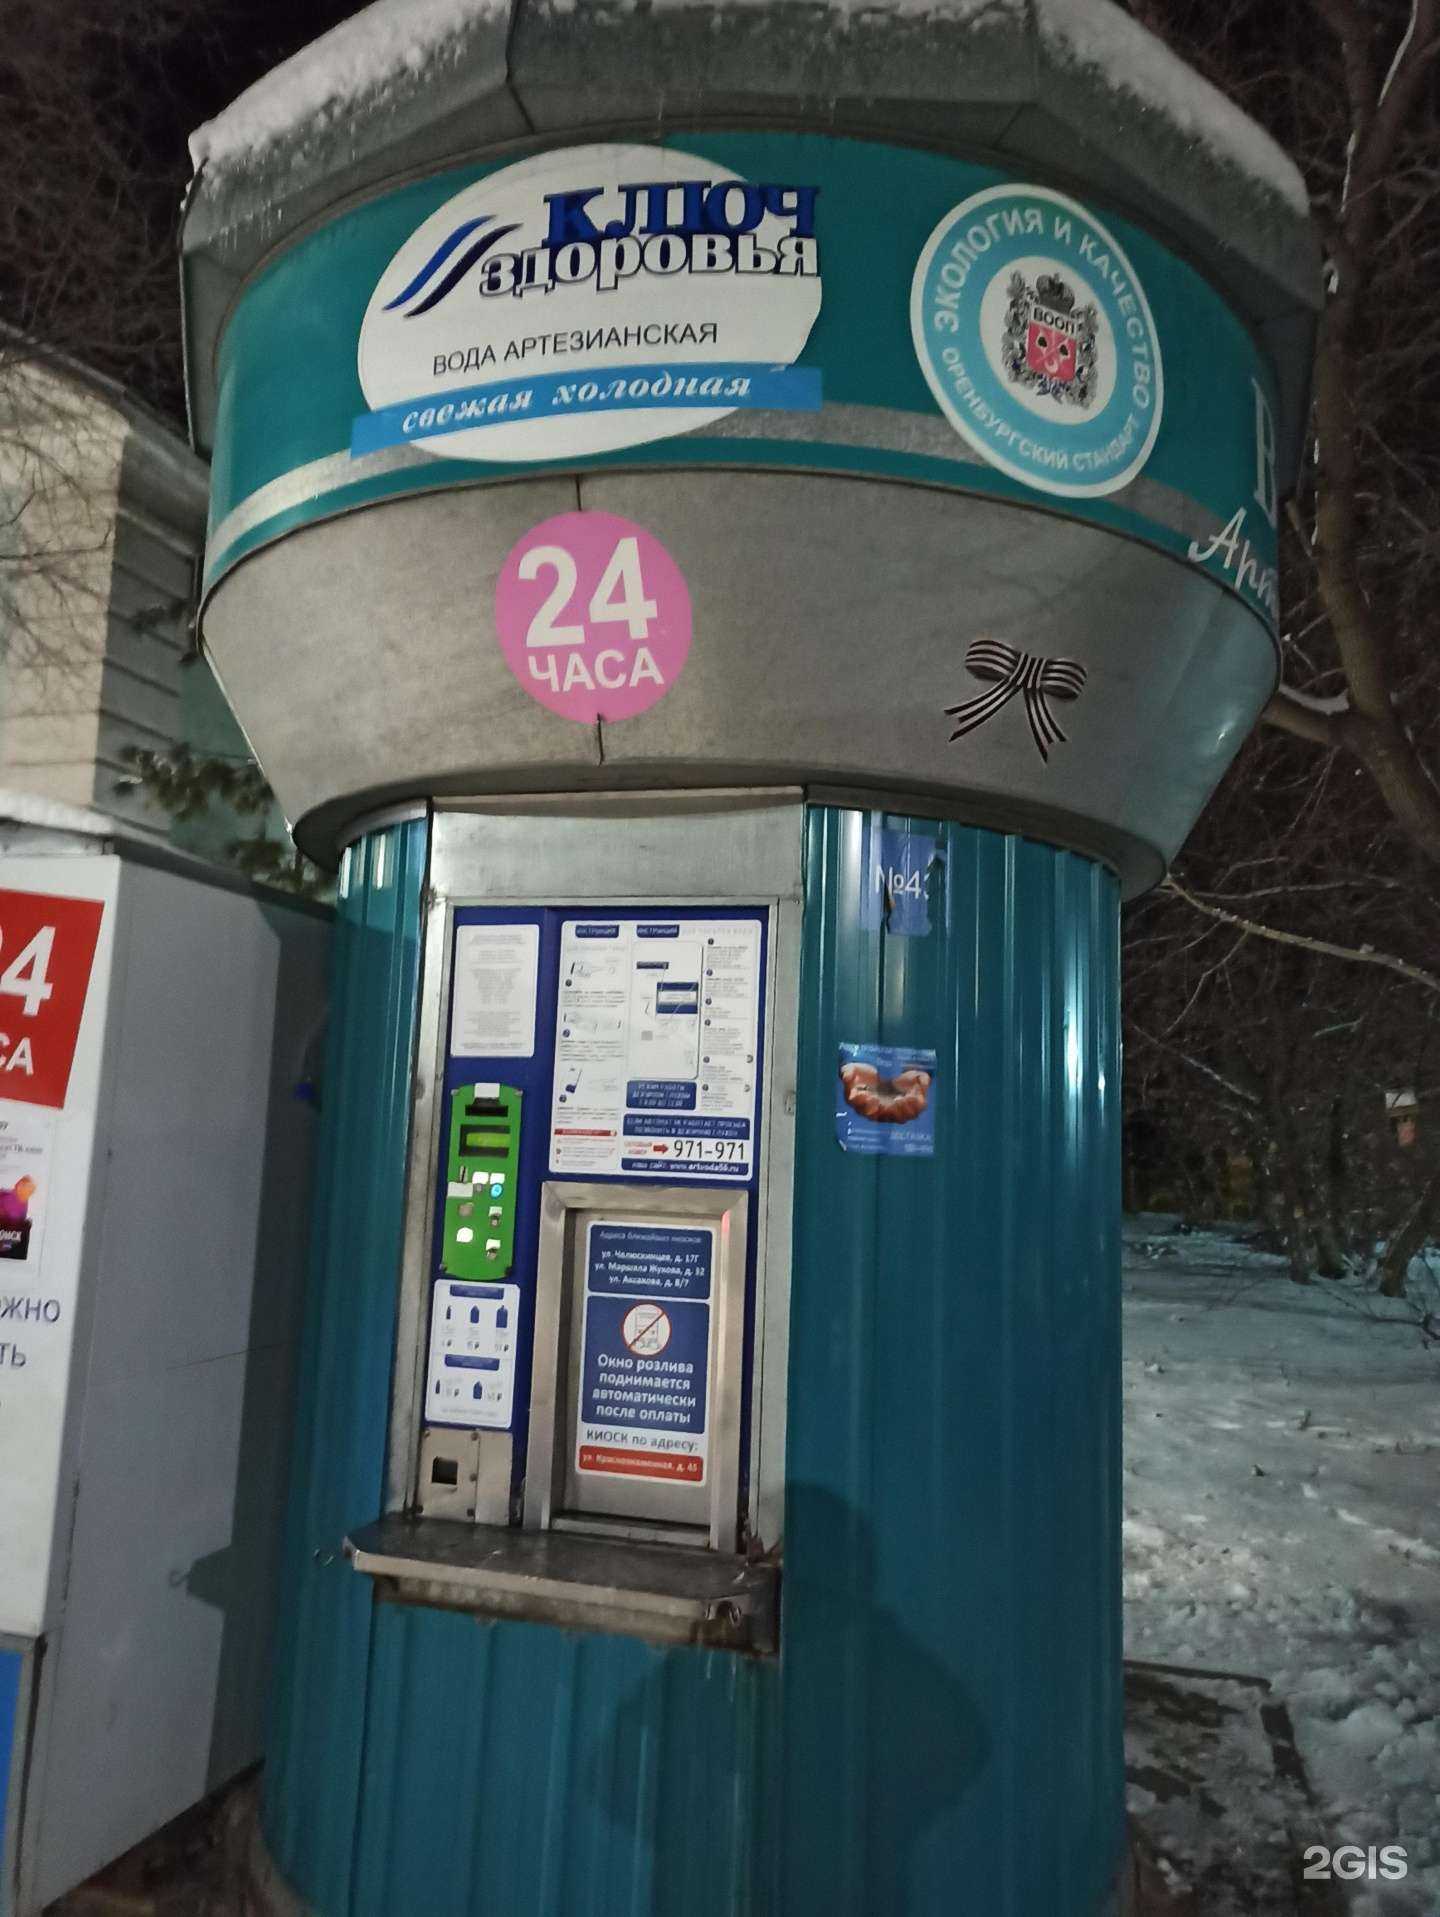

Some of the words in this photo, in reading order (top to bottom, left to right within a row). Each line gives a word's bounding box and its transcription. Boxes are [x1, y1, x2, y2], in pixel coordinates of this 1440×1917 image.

[543, 179, 822, 247] КЛЮЧ
[479, 231, 818, 297] здоровья
[935, 207, 1044, 333] ЭКОЛОГИЯ
[1053, 215, 1073, 245] И
[1078, 234, 1151, 410] КАЧЕСТВО
[432, 344, 497, 377] ВОДА
[503, 322, 719, 361] АРТЕЗИАНСКАЯ
[401, 389, 533, 434] свежая
[552, 370, 752, 406] холодная
[941, 346, 1070, 470] ОРЕНБУРГСКИЙ
[518, 536, 658, 648] 24
[527, 646, 665, 693] ЧАСА
[875, 864, 930, 900] №4
[0, 925, 57, 1017] 4
[673, 1139, 745, 1160] 971-971
[597, 1353, 634, 1369] Окно
[636, 1358, 694, 1374] розлива
[599, 1372, 691, 1390] поднимается
[592, 1388, 697, 1407] автоматически
[596, 1405, 636, 1418] после
[639, 1409, 691, 1423] оплаты
[586, 1428, 628, 1443] КИОСК
[632, 1435, 648, 1446] по
[650, 1438, 699, 1453] адресу:
